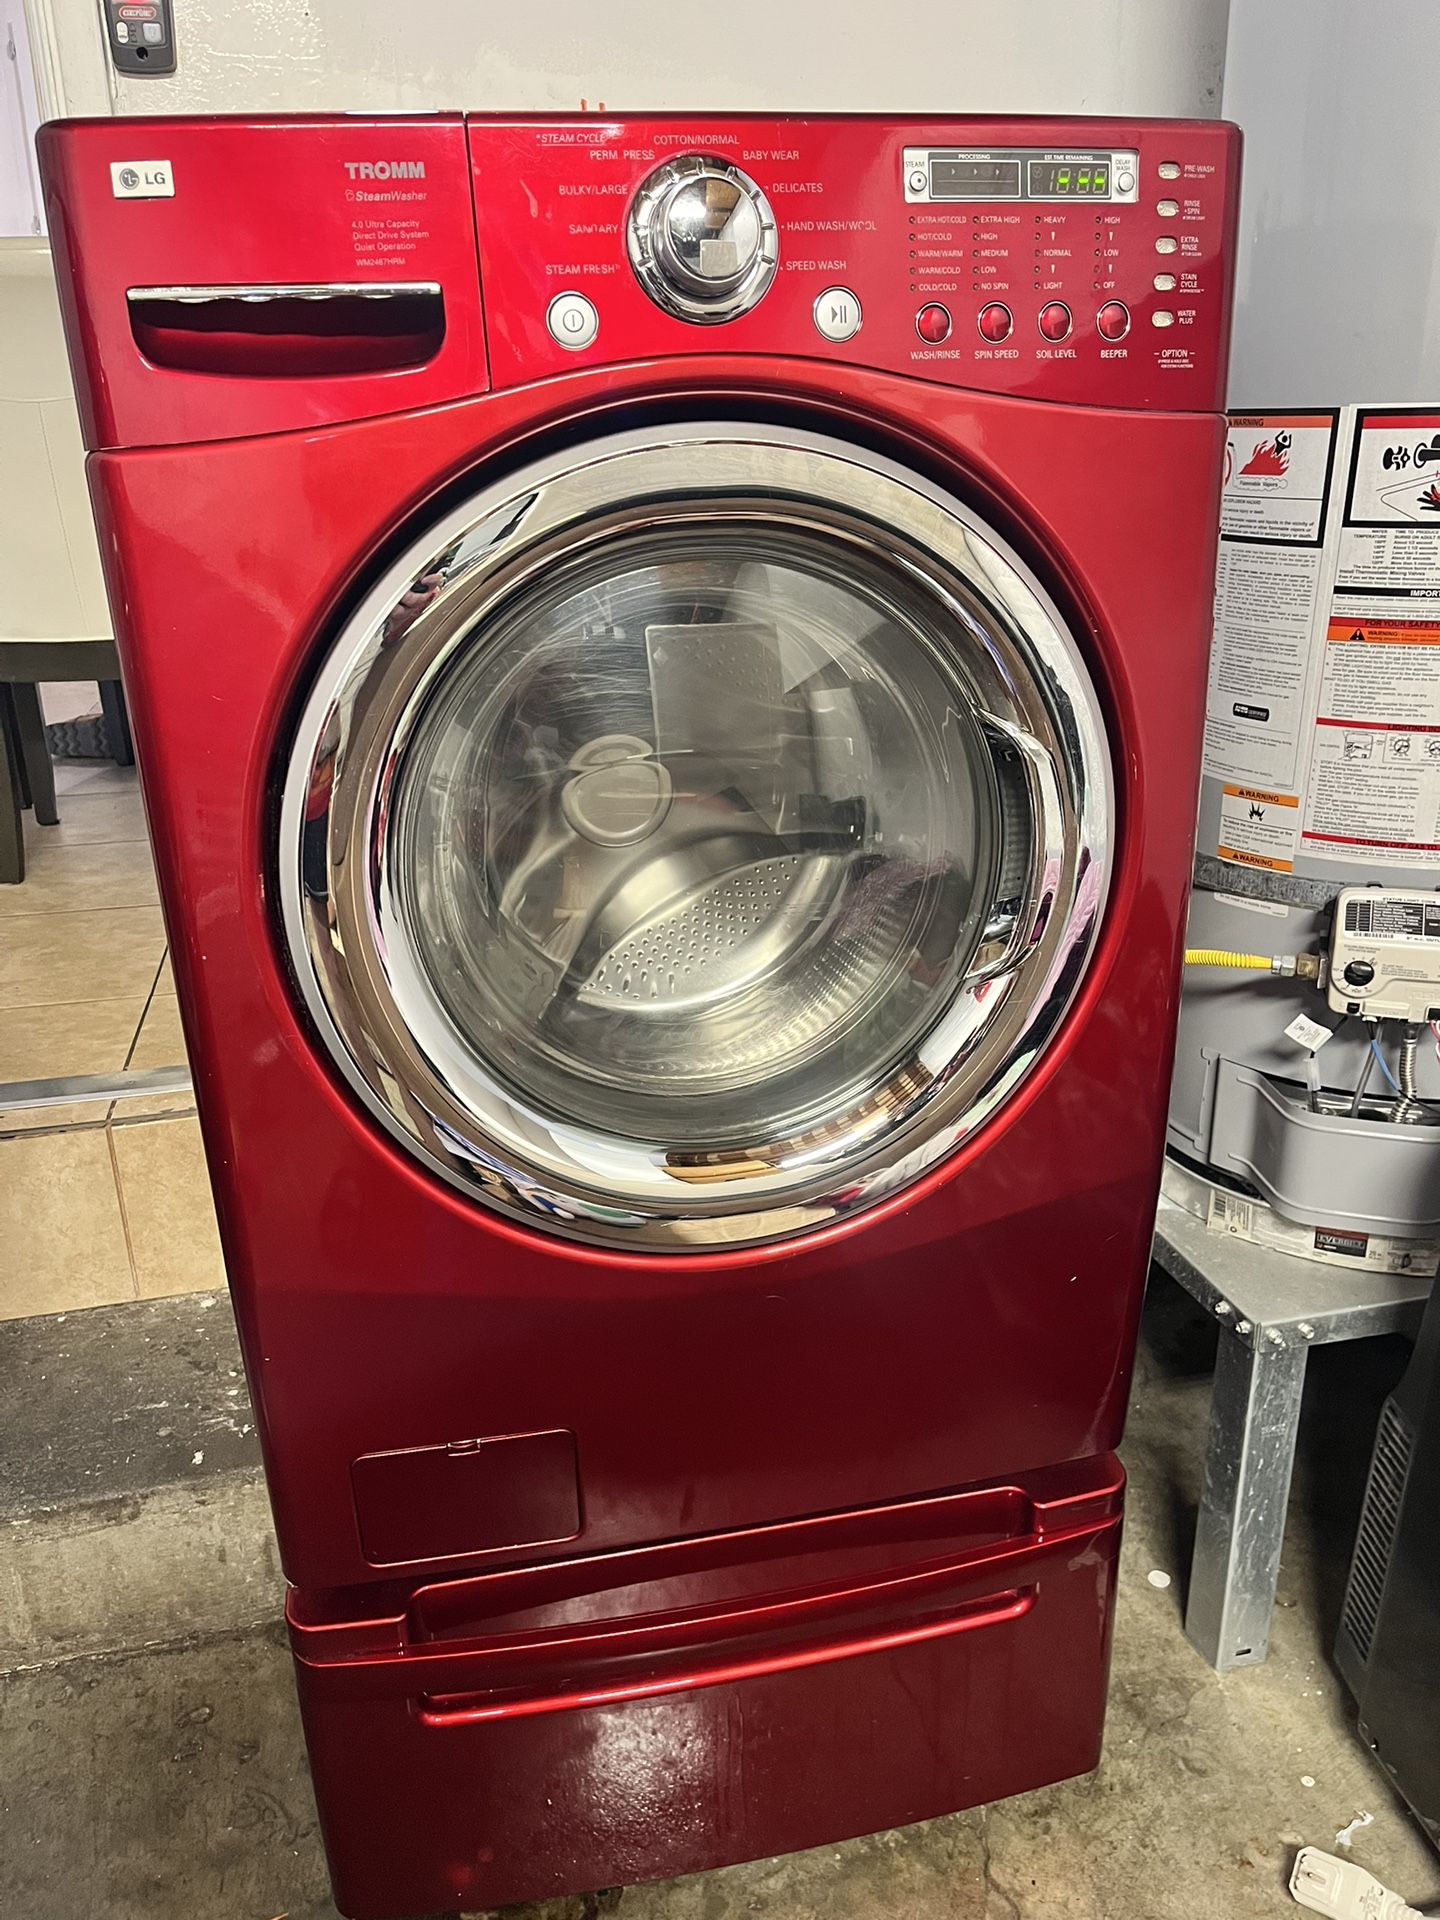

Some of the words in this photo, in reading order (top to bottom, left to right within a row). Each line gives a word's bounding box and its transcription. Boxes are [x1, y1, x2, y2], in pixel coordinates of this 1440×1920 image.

[577, 134, 606, 143] CYCLE
[654, 135, 740, 145] COTTON/NORMAL
[590, 150, 618, 160] PERM
[624, 150, 655, 160] PRESS
[743, 151, 768, 160] BABY
[771, 151, 800, 160] WEAR
[344, 161, 426, 179] TROMM
[1185, 165, 1215, 173] PRE-WASH
[145, 172, 166, 184] LG
[559, 185, 628, 195] BULKY/LARGE
[773, 183, 823, 193] DELICATES
[355, 191, 427, 201] SteamWasher
[352, 220, 363, 228] 4.0
[365, 220, 384, 228] Ultra
[386, 220, 420, 229] Capacity
[786, 222, 814, 231] HAND
[817, 221, 877, 231] WASH/WOOL
[353, 232, 376, 240] Direct
[378, 231, 398, 239] Drive
[400, 231, 429, 239] System
[354, 243, 375, 251] Quiet
[377, 242, 416, 252] Operation
[545, 265, 580, 275] STEAM
[786, 261, 815, 270] SPEED
[819, 261, 847, 270] WASH
[911, 350, 960, 360] WASH/RINSE
[975, 350, 992, 359] SPIN
[994, 350, 1019, 359] SPEED
[1036, 350, 1053, 359] SOIL
[1055, 349, 1077, 358] LEVEL
[1100, 349, 1128, 358] BEEPER
[1162, 349, 1188, 357] OPTION
[1245, 789, 1279, 802] WARNING
[1239, 853, 1273, 866] WARNING
